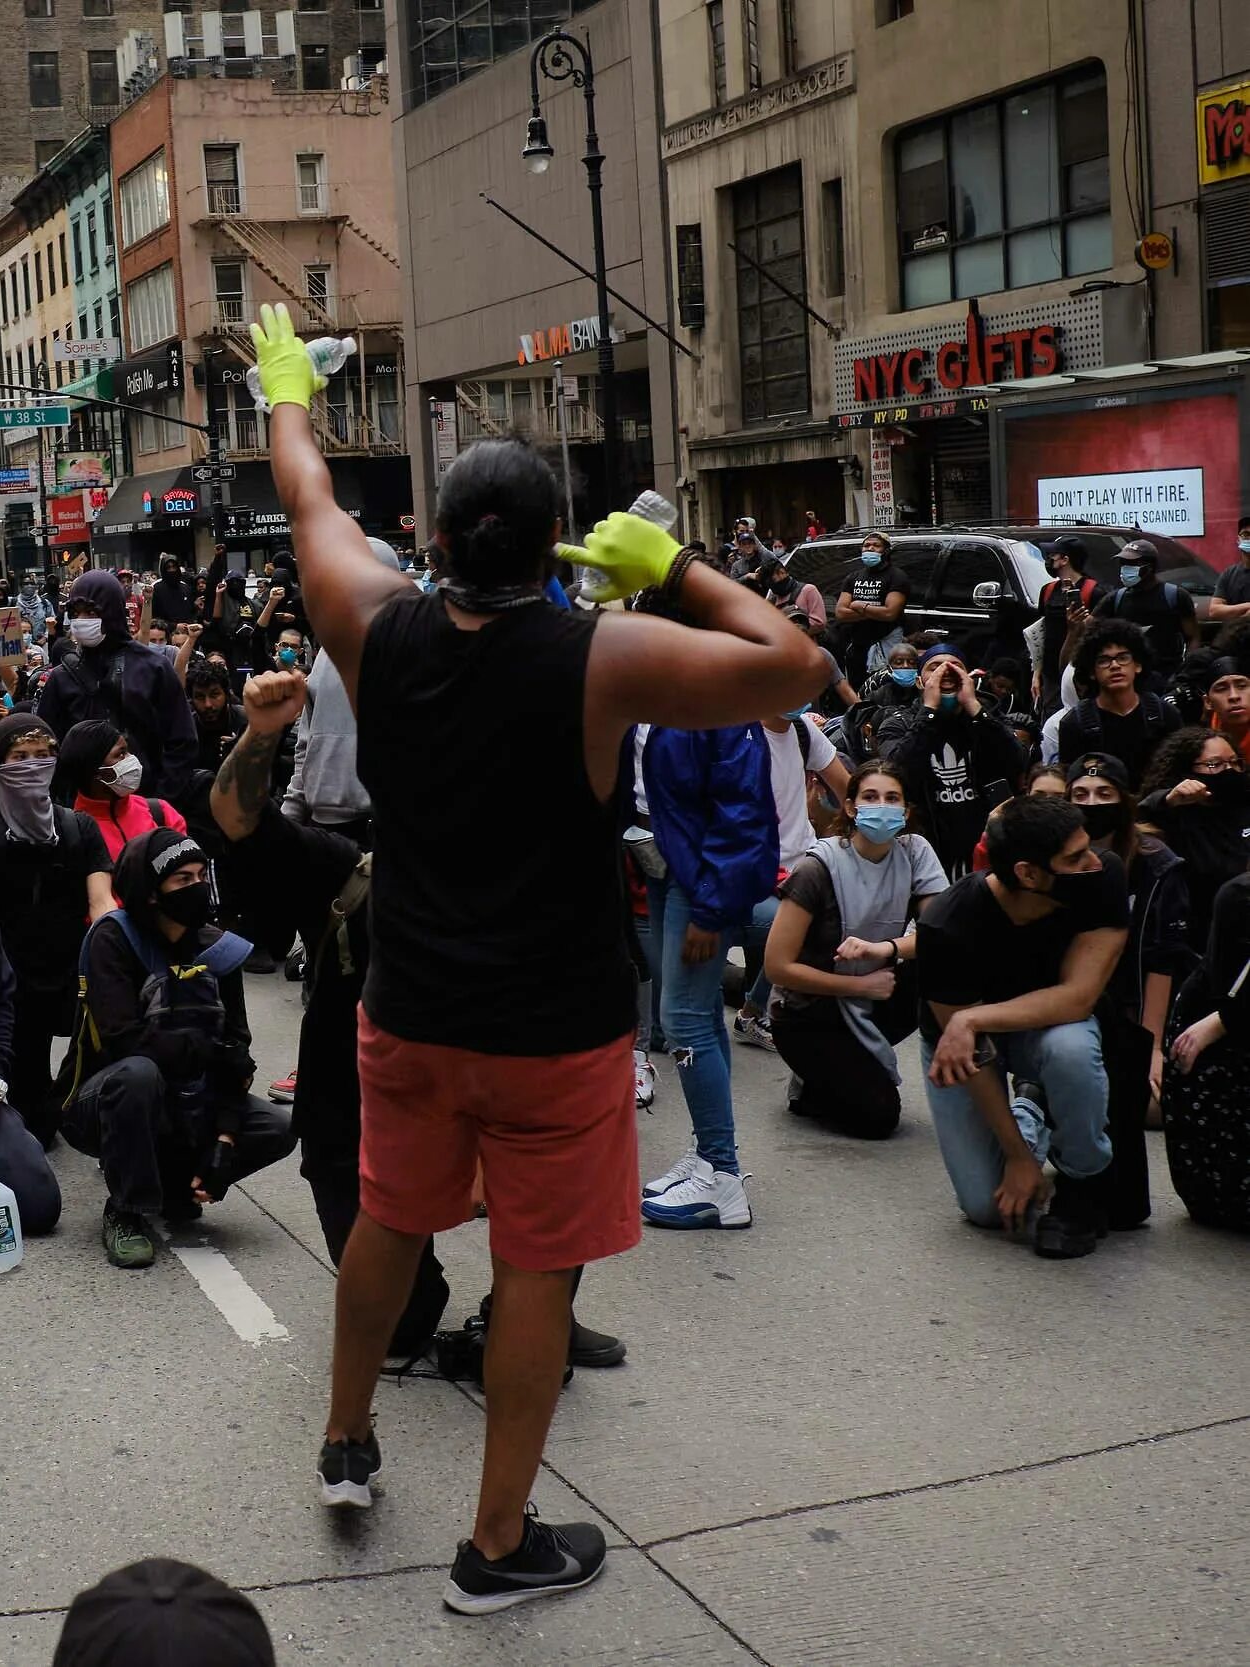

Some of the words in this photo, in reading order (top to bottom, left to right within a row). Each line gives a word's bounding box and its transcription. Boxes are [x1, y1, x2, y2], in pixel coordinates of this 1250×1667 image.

[721, 100, 762, 128] CENTER
[768, 59, 848, 110] SYNAGOGUE
[534, 324, 572, 361] ALMA
[572, 316, 616, 352] BAN
[170, 350, 180, 387] NAILS
[854, 347, 926, 401] NYC
[126, 376, 142, 396] Polish
[143, 369, 154, 389] Me
[3, 412, 13, 424] W
[16, 411, 31, 424] 38
[34, 409, 46, 422] St
[849, 414, 863, 425] NY
[874, 411, 887, 424] NY
[894, 408, 908, 421] PD
[1051, 490, 1083, 508] DON'T
[1088, 488, 1116, 506] PLAY
[1122, 485, 1152, 504] WITH
[1157, 484, 1189, 502] FIRE.
[166, 500, 193, 512] DELI
[875, 506, 893, 517] NYPD
[170, 519, 190, 528] 1017
[256, 514, 287, 524] MARKE
[1123, 511, 1140, 524] GET
[1142, 508, 1190, 524] SCANNED.
[935, 787, 978, 802] dida
